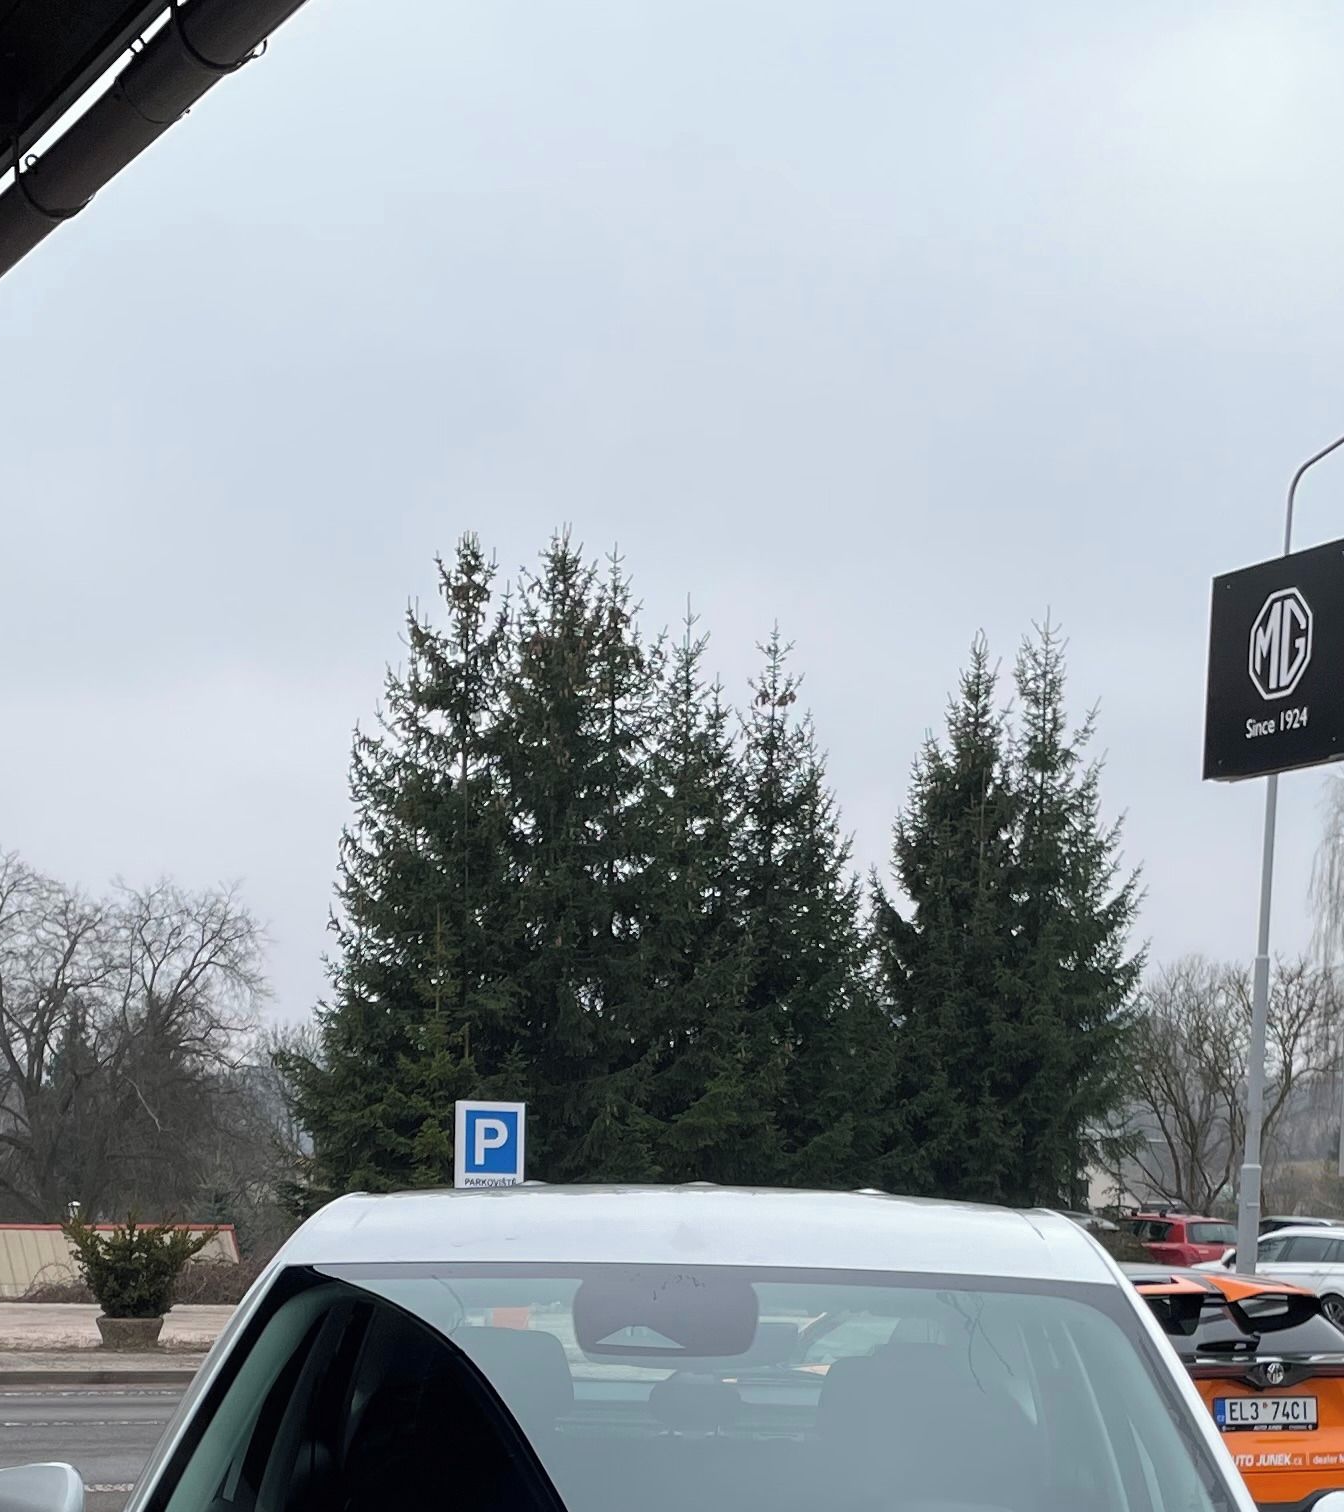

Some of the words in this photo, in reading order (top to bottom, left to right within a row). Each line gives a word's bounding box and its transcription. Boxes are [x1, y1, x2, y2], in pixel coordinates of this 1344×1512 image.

[1254, 596, 1307, 690] MG
[1245, 718, 1276, 739] Since
[1280, 707, 1308, 732] 1924
[474, 1118, 508, 1166] P
[1229, 1401, 1259, 1421] EL3
[1271, 1401, 1307, 1421] 74CI
[1231, 1454, 1255, 1467] UTO
[1312, 1454, 1338, 1465] dealer
